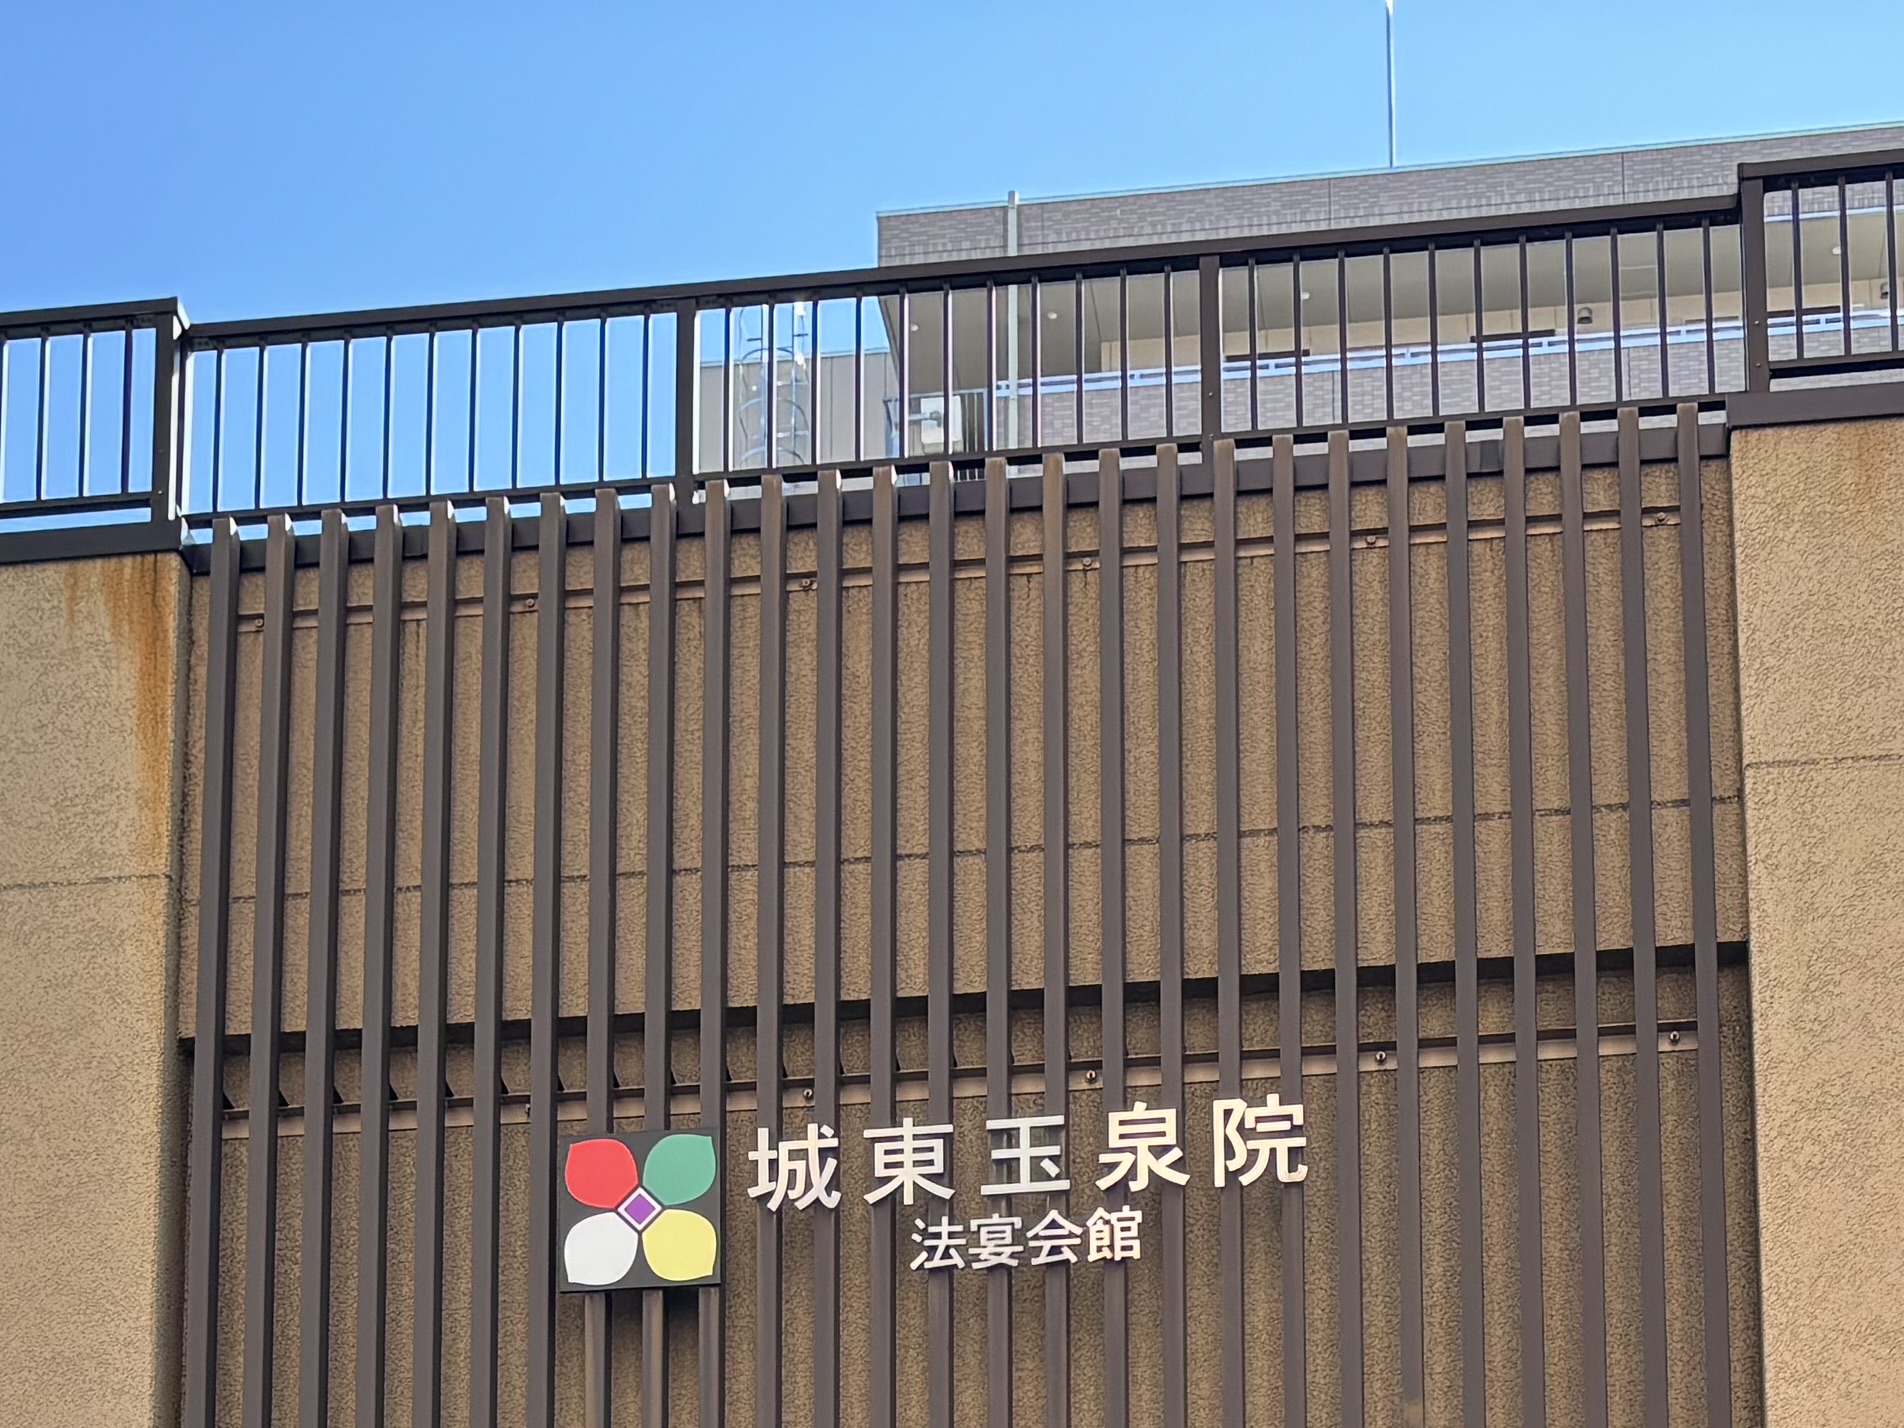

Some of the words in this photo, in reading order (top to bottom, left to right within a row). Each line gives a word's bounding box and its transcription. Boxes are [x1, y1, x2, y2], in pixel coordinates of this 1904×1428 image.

[747, 1093, 1309, 1212] 城東玉泉院
[910, 1204, 1143, 1271] 法宴会館
